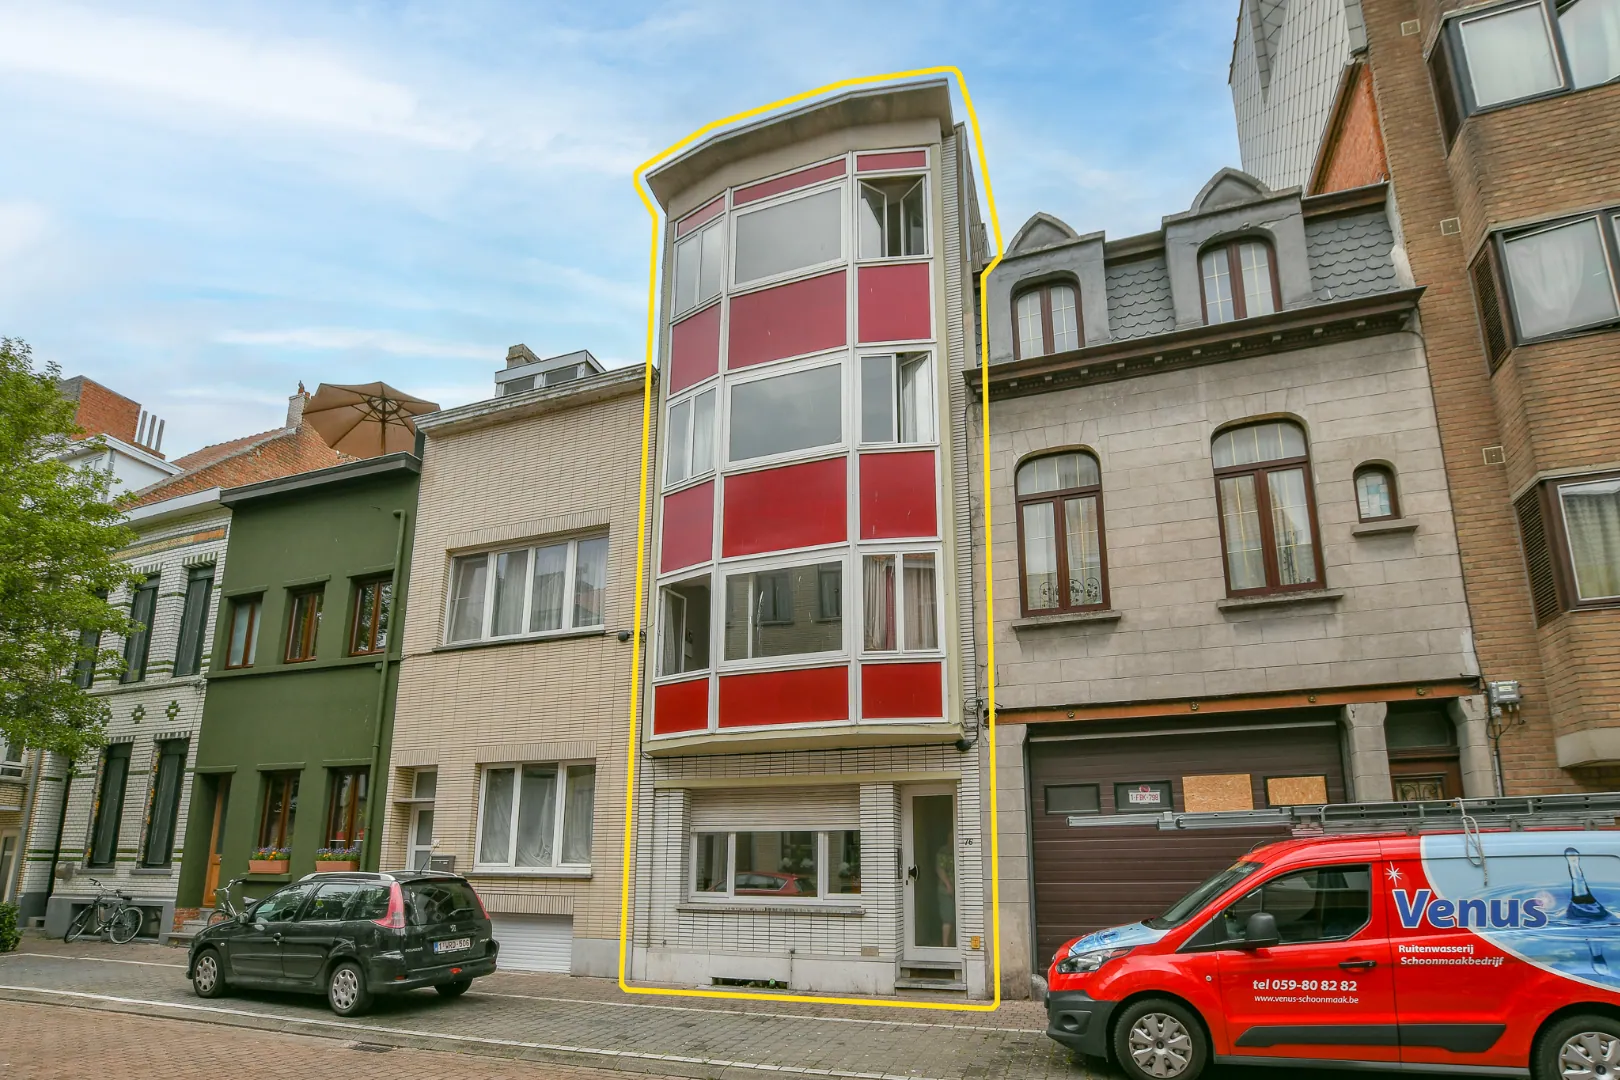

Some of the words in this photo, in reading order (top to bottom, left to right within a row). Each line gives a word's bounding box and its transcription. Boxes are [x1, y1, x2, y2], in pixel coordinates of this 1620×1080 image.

[1392, 888, 1548, 929] Venus
[1398, 944, 1474, 954] Ruitenwasserij
[1400, 956, 1504, 968] Schoonmaakbedrijf
[1253, 979, 1270, 990] tel
[1272, 979, 1318, 991] 059-80
[1320, 980, 1337, 991] 82
[1340, 980, 1357, 992] 82
[1254, 995, 1359, 1004] www.venus-schoonmaak.be
